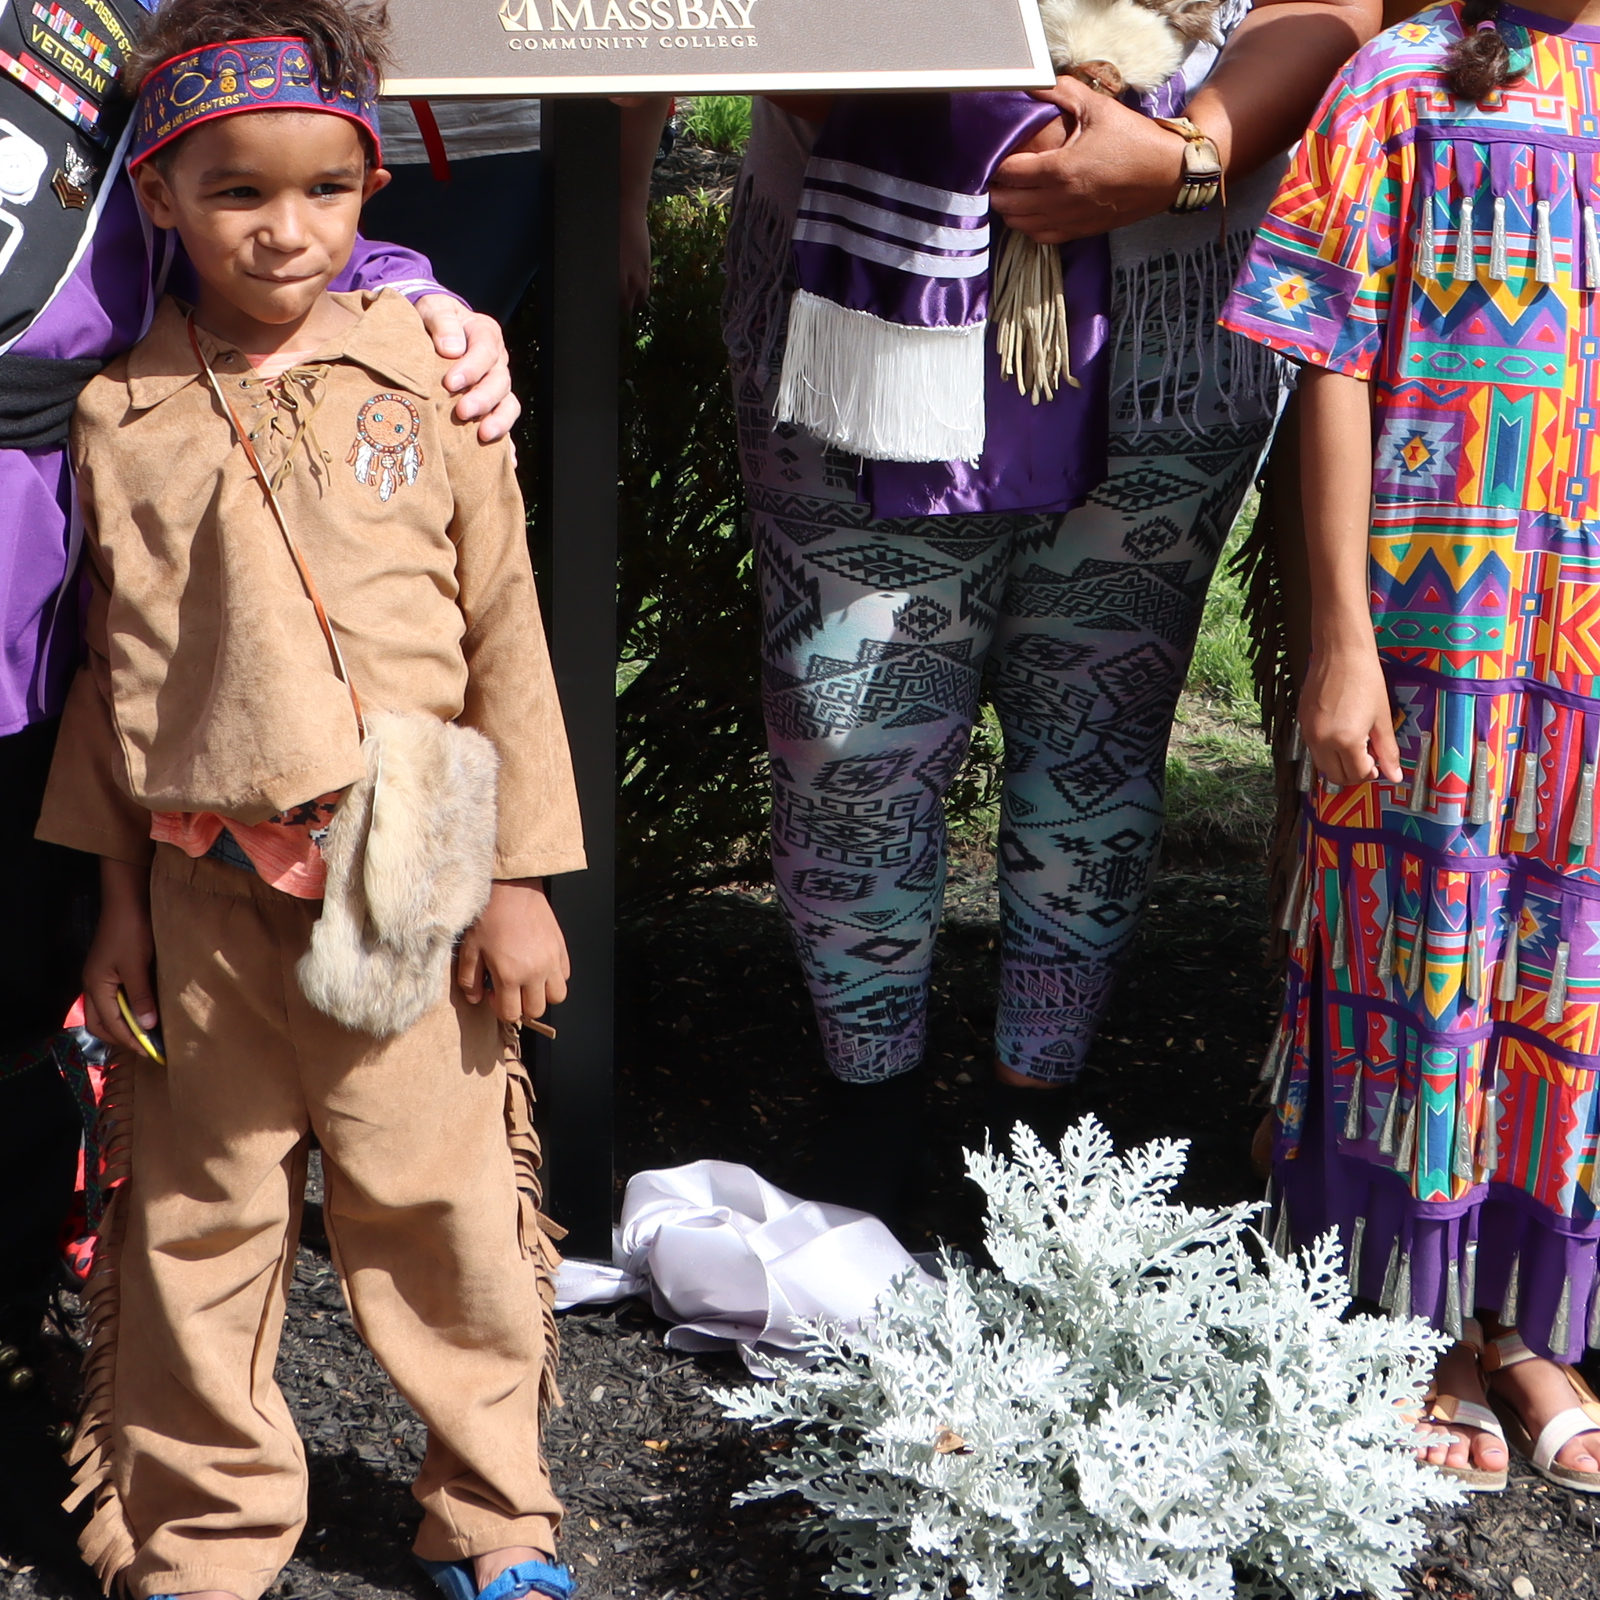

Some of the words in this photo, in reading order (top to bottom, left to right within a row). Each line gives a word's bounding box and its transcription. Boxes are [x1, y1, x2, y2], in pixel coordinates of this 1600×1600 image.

[94, 0, 125, 41] DESERT
[30, 24, 106, 94] VETERAN
[509, 36, 649, 50] COMMUNITY
[659, 35, 758, 48] COLLEGE
[156, 120, 172, 138] SONS
[172, 113, 185, 131] AND
